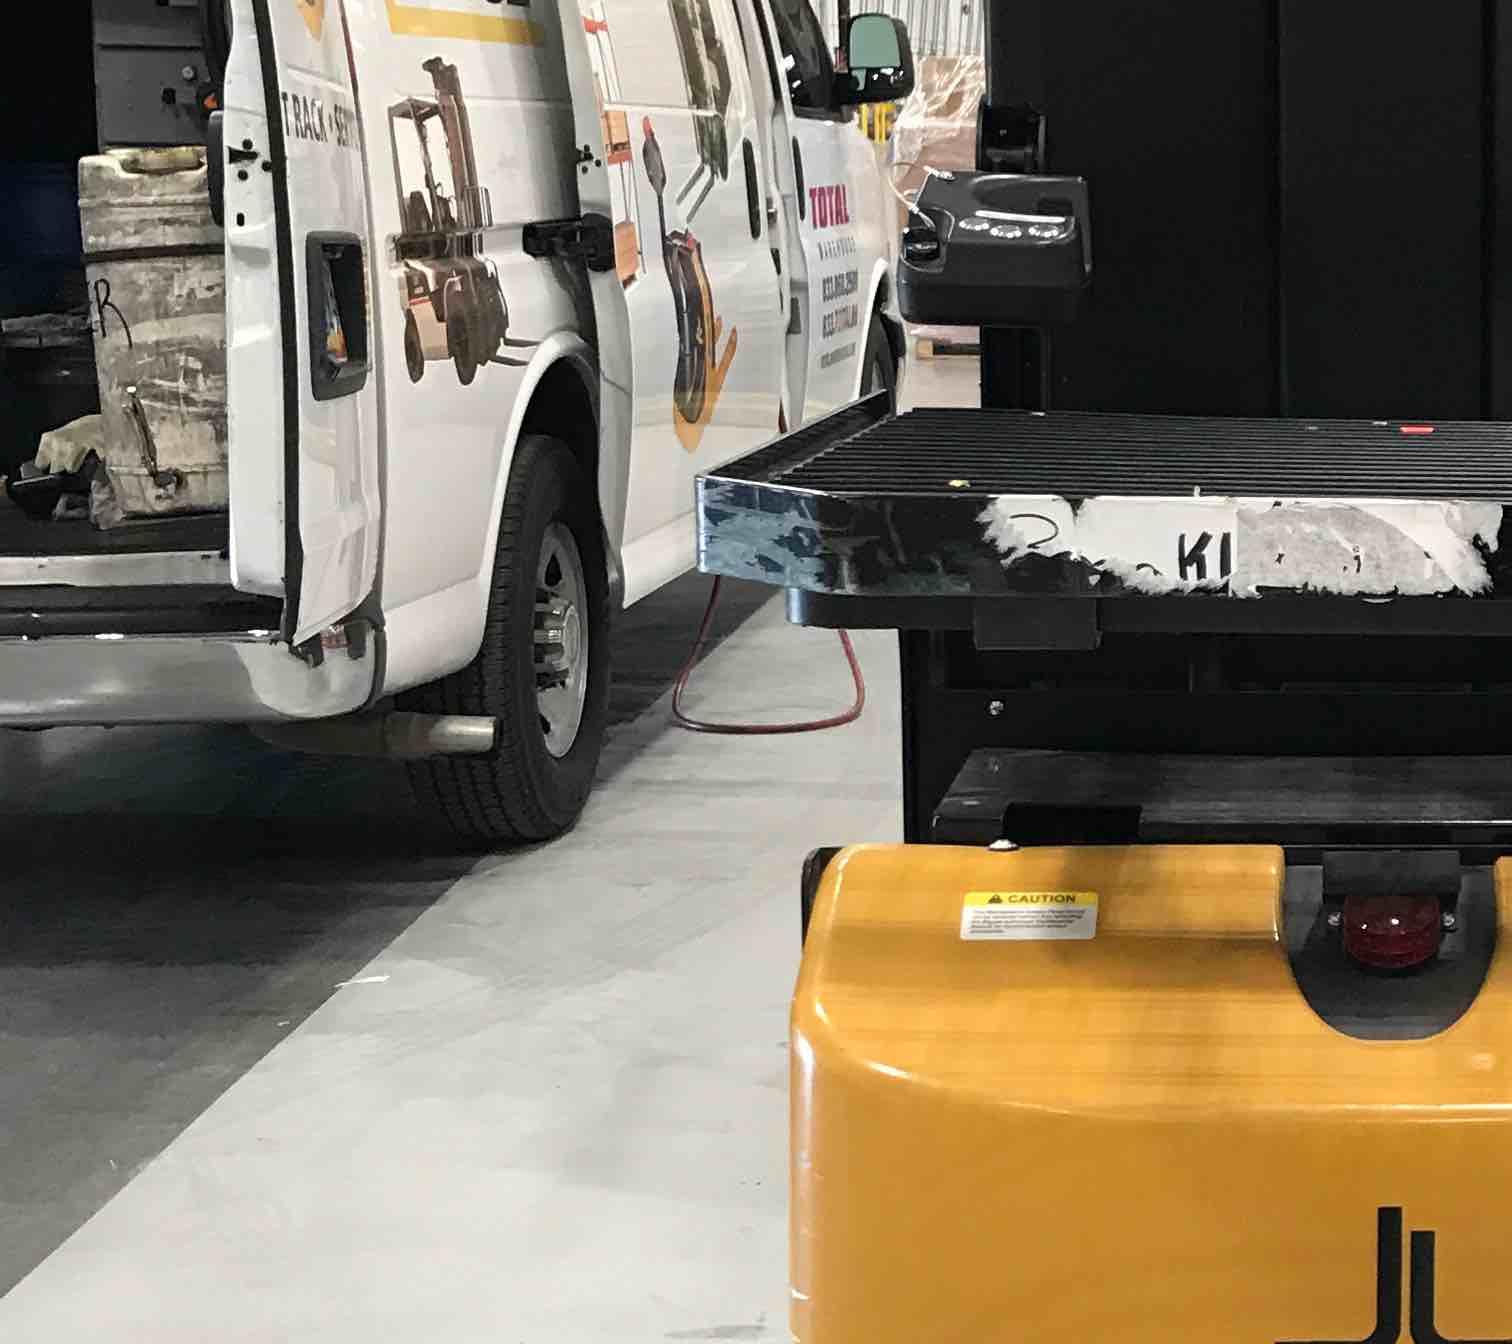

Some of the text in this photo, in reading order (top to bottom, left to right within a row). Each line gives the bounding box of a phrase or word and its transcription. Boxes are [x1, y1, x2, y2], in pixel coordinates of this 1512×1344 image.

[292, 94, 328, 143] RACK
[809, 184, 849, 230] TOTAL
[1008, 894, 1076, 905] CAUTION
